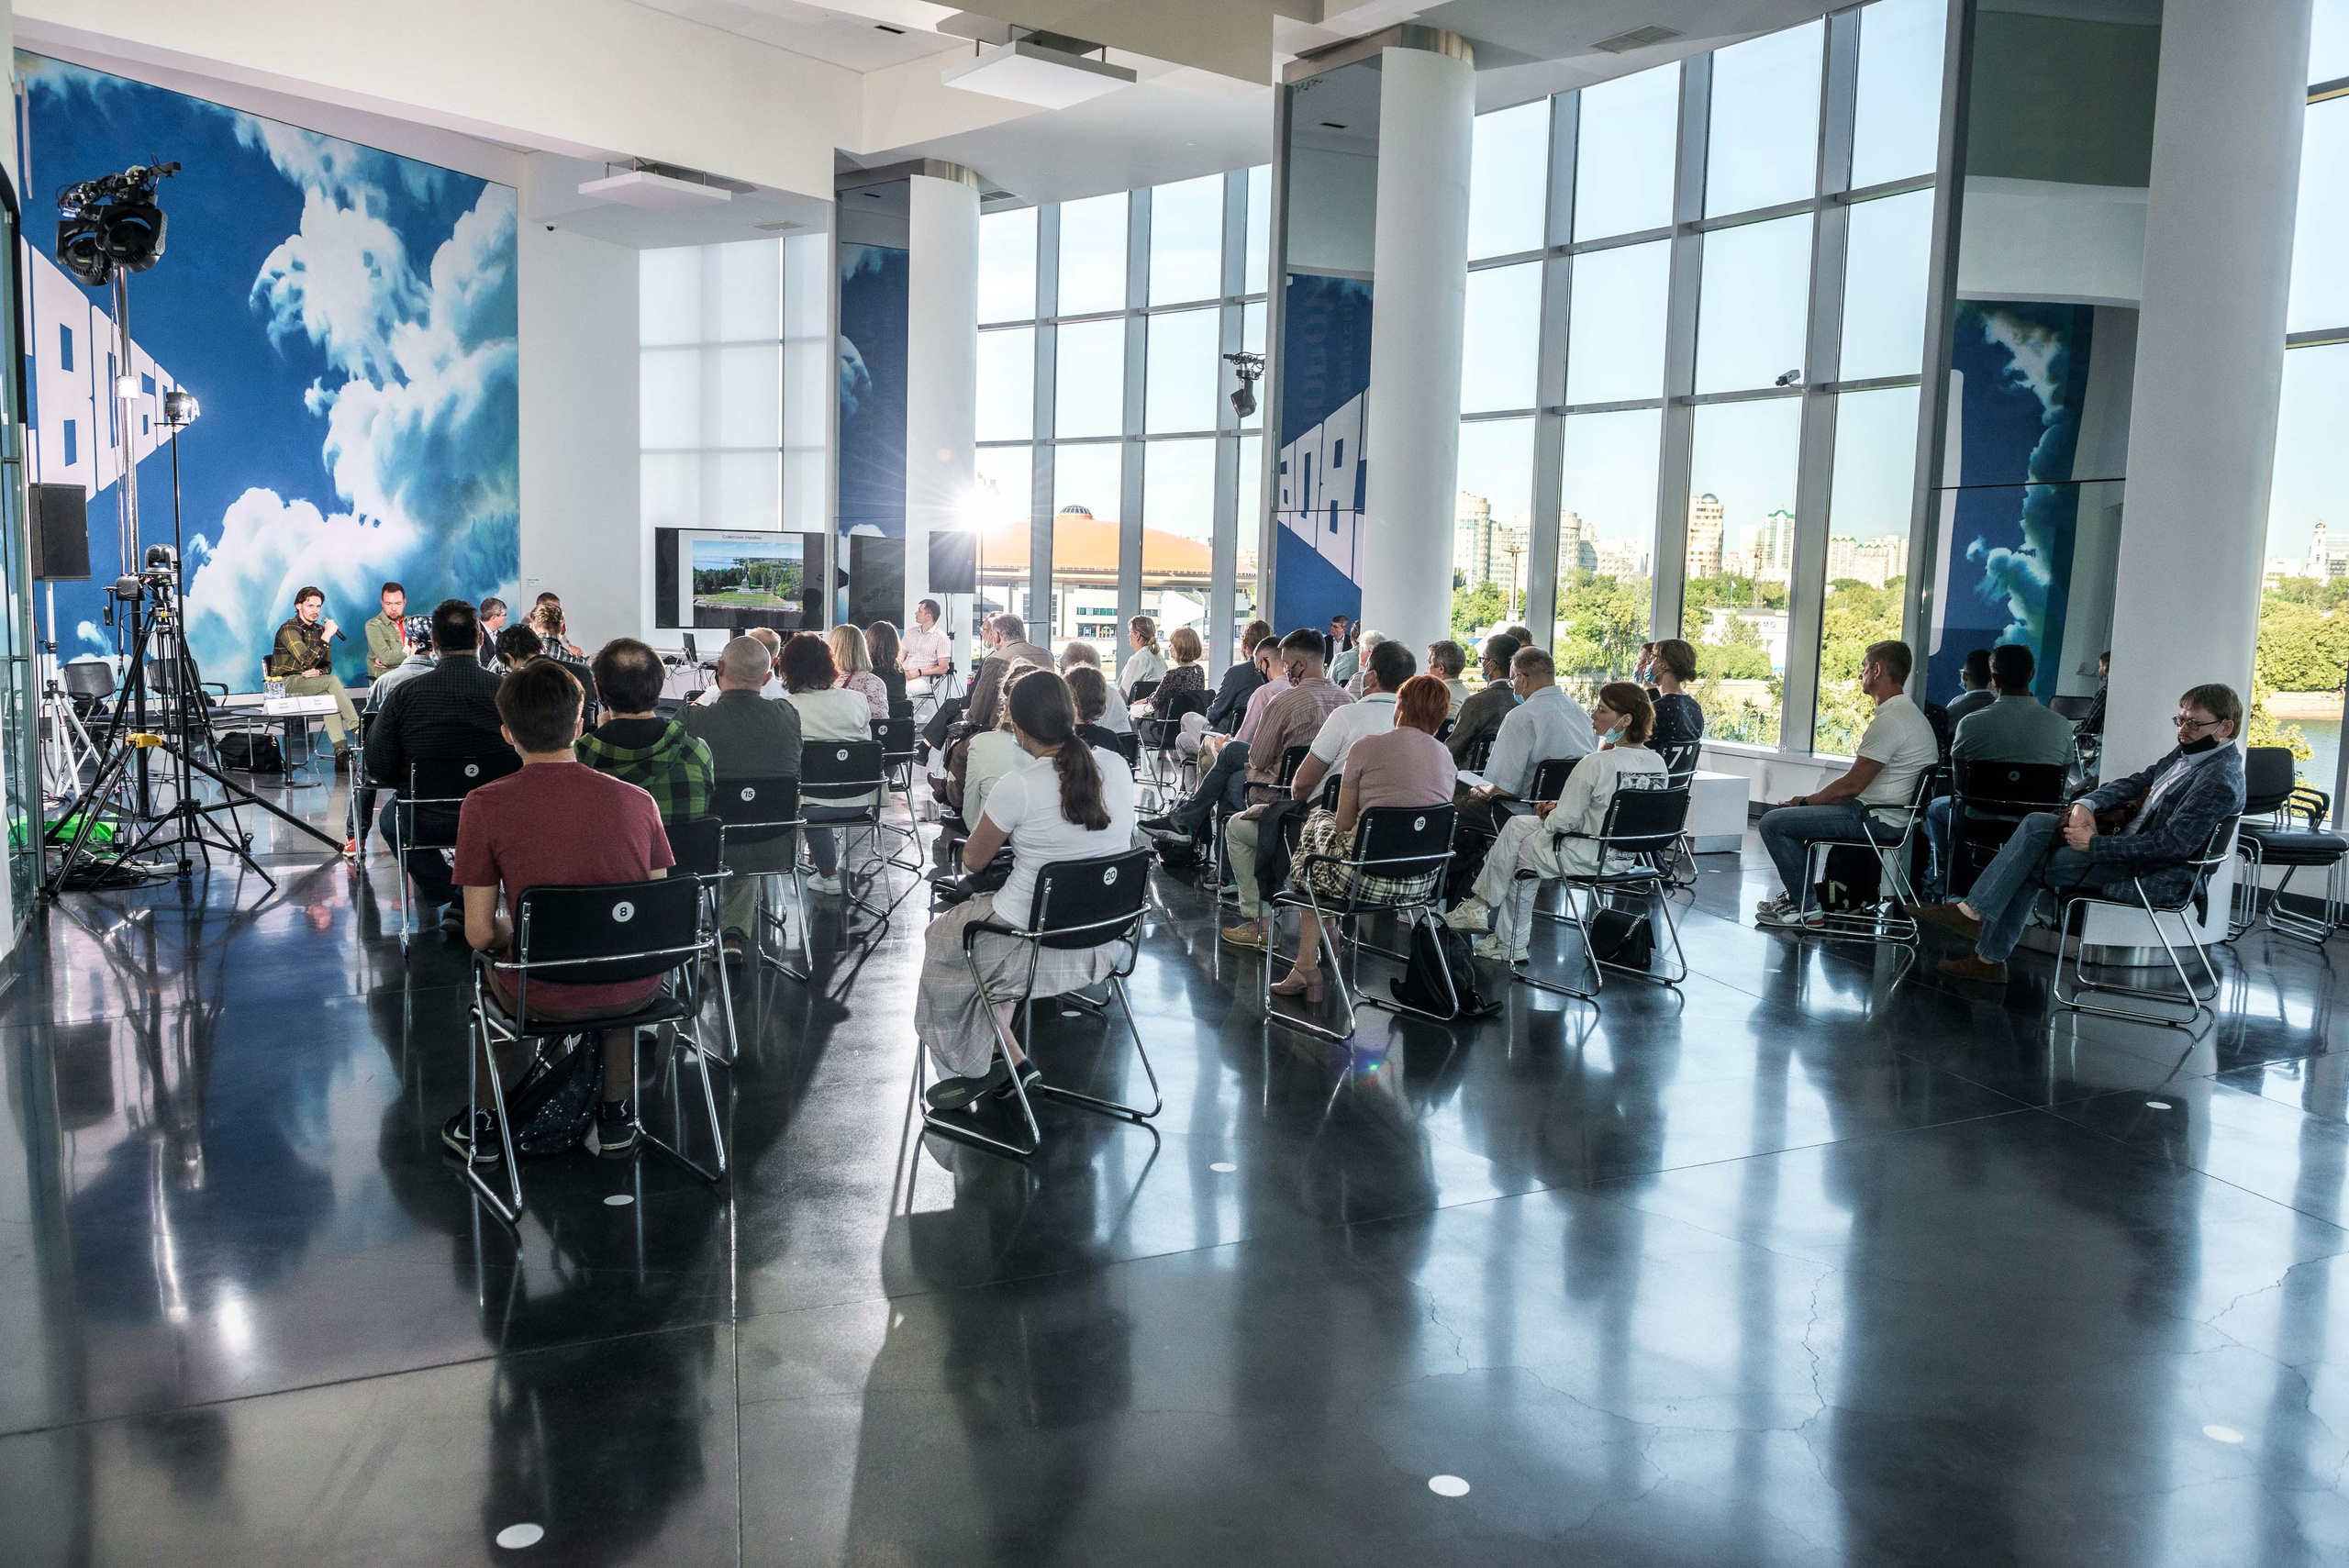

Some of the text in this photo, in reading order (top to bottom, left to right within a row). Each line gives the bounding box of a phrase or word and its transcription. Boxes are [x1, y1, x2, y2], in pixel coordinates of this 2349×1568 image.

[22, 235, 201, 502] ВОБОА
[1106, 871, 1116, 881] 20
[620, 907, 628, 917] 8
